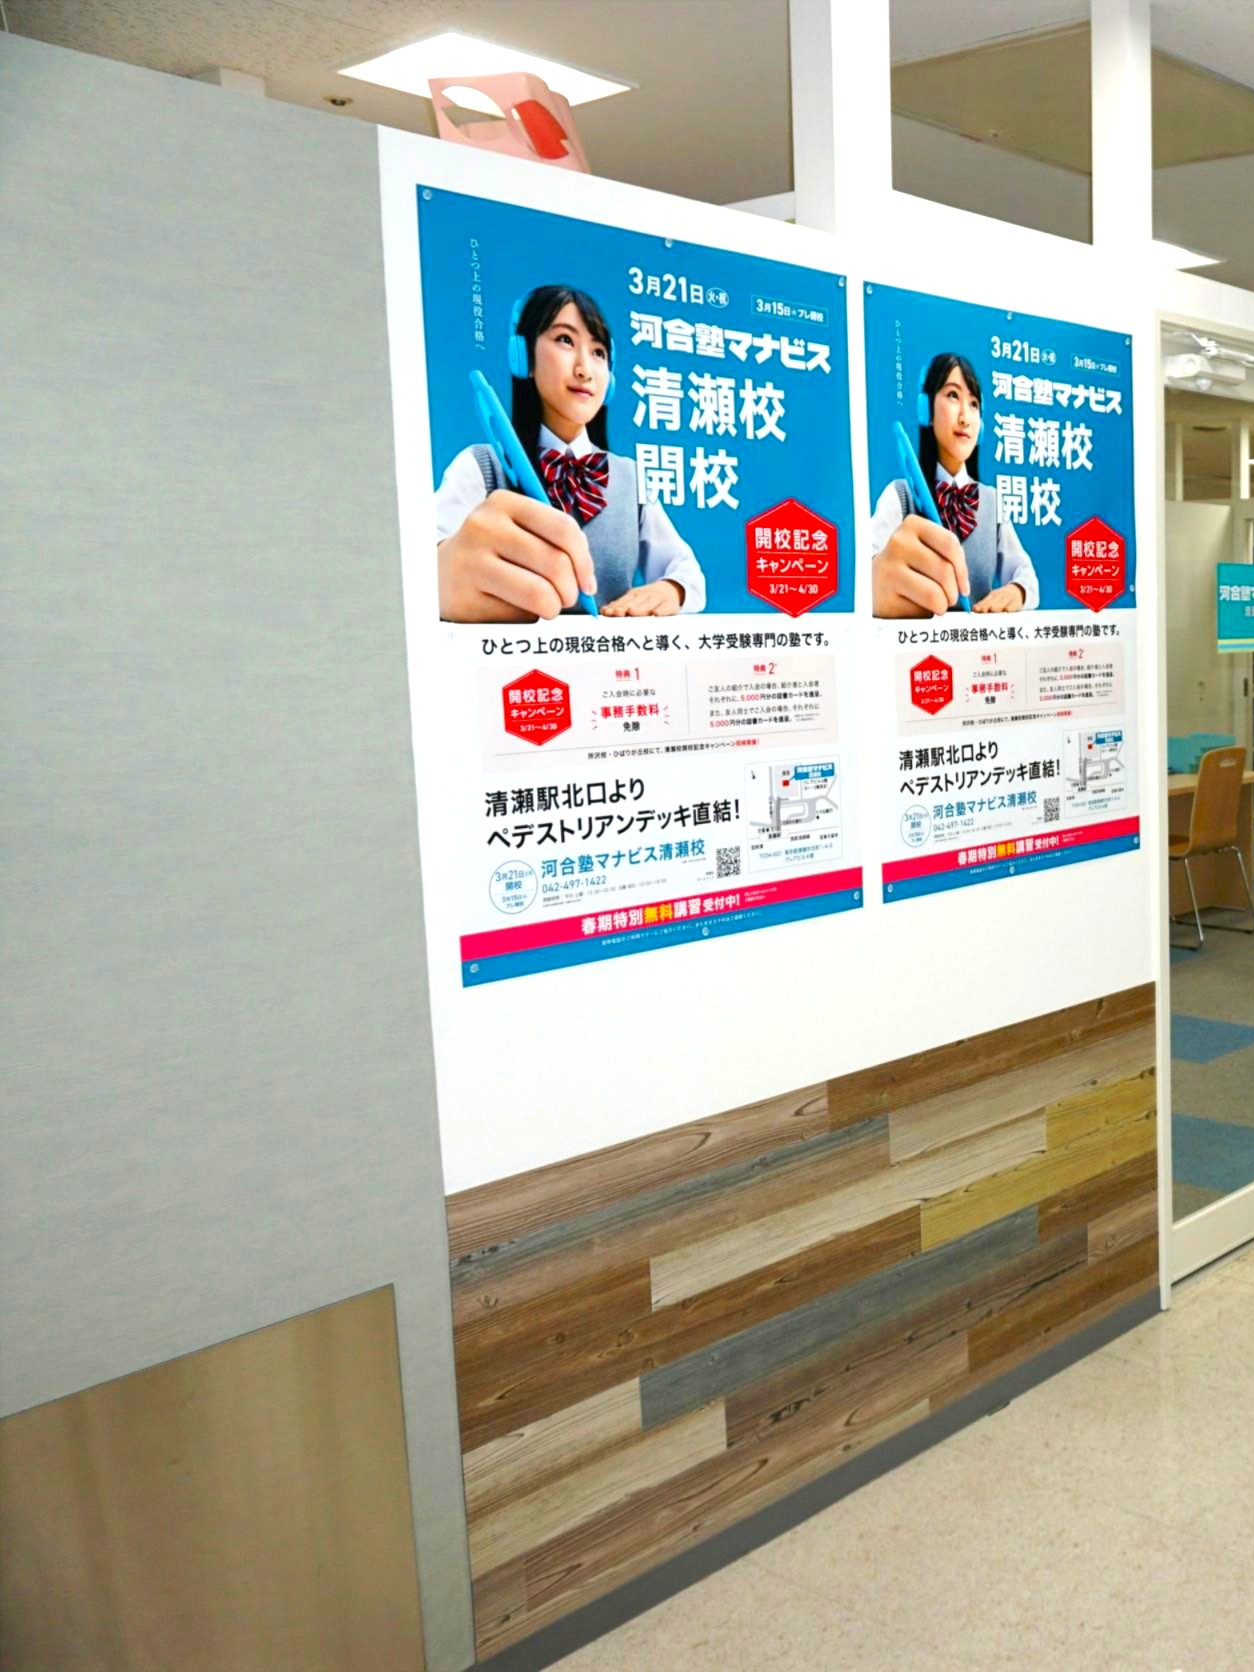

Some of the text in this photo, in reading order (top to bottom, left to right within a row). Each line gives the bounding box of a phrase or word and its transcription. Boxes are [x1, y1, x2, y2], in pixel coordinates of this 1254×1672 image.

[470, 238, 486, 351] ひとつ上の現役合格へ
[628, 266, 704, 305] 3月21日
[629, 310, 832, 375] 河合塾マナビス
[991, 336, 1040, 364] 3月21日
[631, 364, 787, 443] 清瀬校
[992, 370, 1122, 415] 河合塾マナビス
[993, 412, 1093, 471] 清瀬校
[635, 443, 740, 510] 開校
[996, 474, 1062, 526] 開校
[754, 526, 829, 551] 開校記念
[1071, 539, 1120, 559] 開校記念
[755, 556, 829, 575] キャンペーン
[1071, 563, 1120, 577] キャンペーン
[482, 631, 833, 656] ひとつ上の現役合格へと導く、大学受験専門の塾です。
[898, 624, 1121, 645] ひとつ上の現役合格へと導く、大学受験専門の塾です。
[634, 667, 640, 681] 1
[913, 669, 949, 681] 開校記念
[508, 687, 564, 704] 開校記念
[914, 684, 949, 694] キャンペーン
[510, 706, 564, 718] キャンペーン
[601, 703, 660, 719] 事務手数料
[623, 721, 641, 732] 免除
[899, 740, 999, 771] 清瀬駅北口より
[899, 758, 1061, 796] ペデストリアンデッキ直結!
[485, 777, 646, 817] 清瀬駅北口より
[933, 790, 1037, 820] 河合塾マナビス清瀬校
[486, 798, 741, 851] ペデストリアンデッキ直結!
[933, 817, 975, 833] 042-497-1422
[541, 838, 705, 879] 河合塾マナビス清瀬校
[542, 875, 608, 893] 042-497-1422
